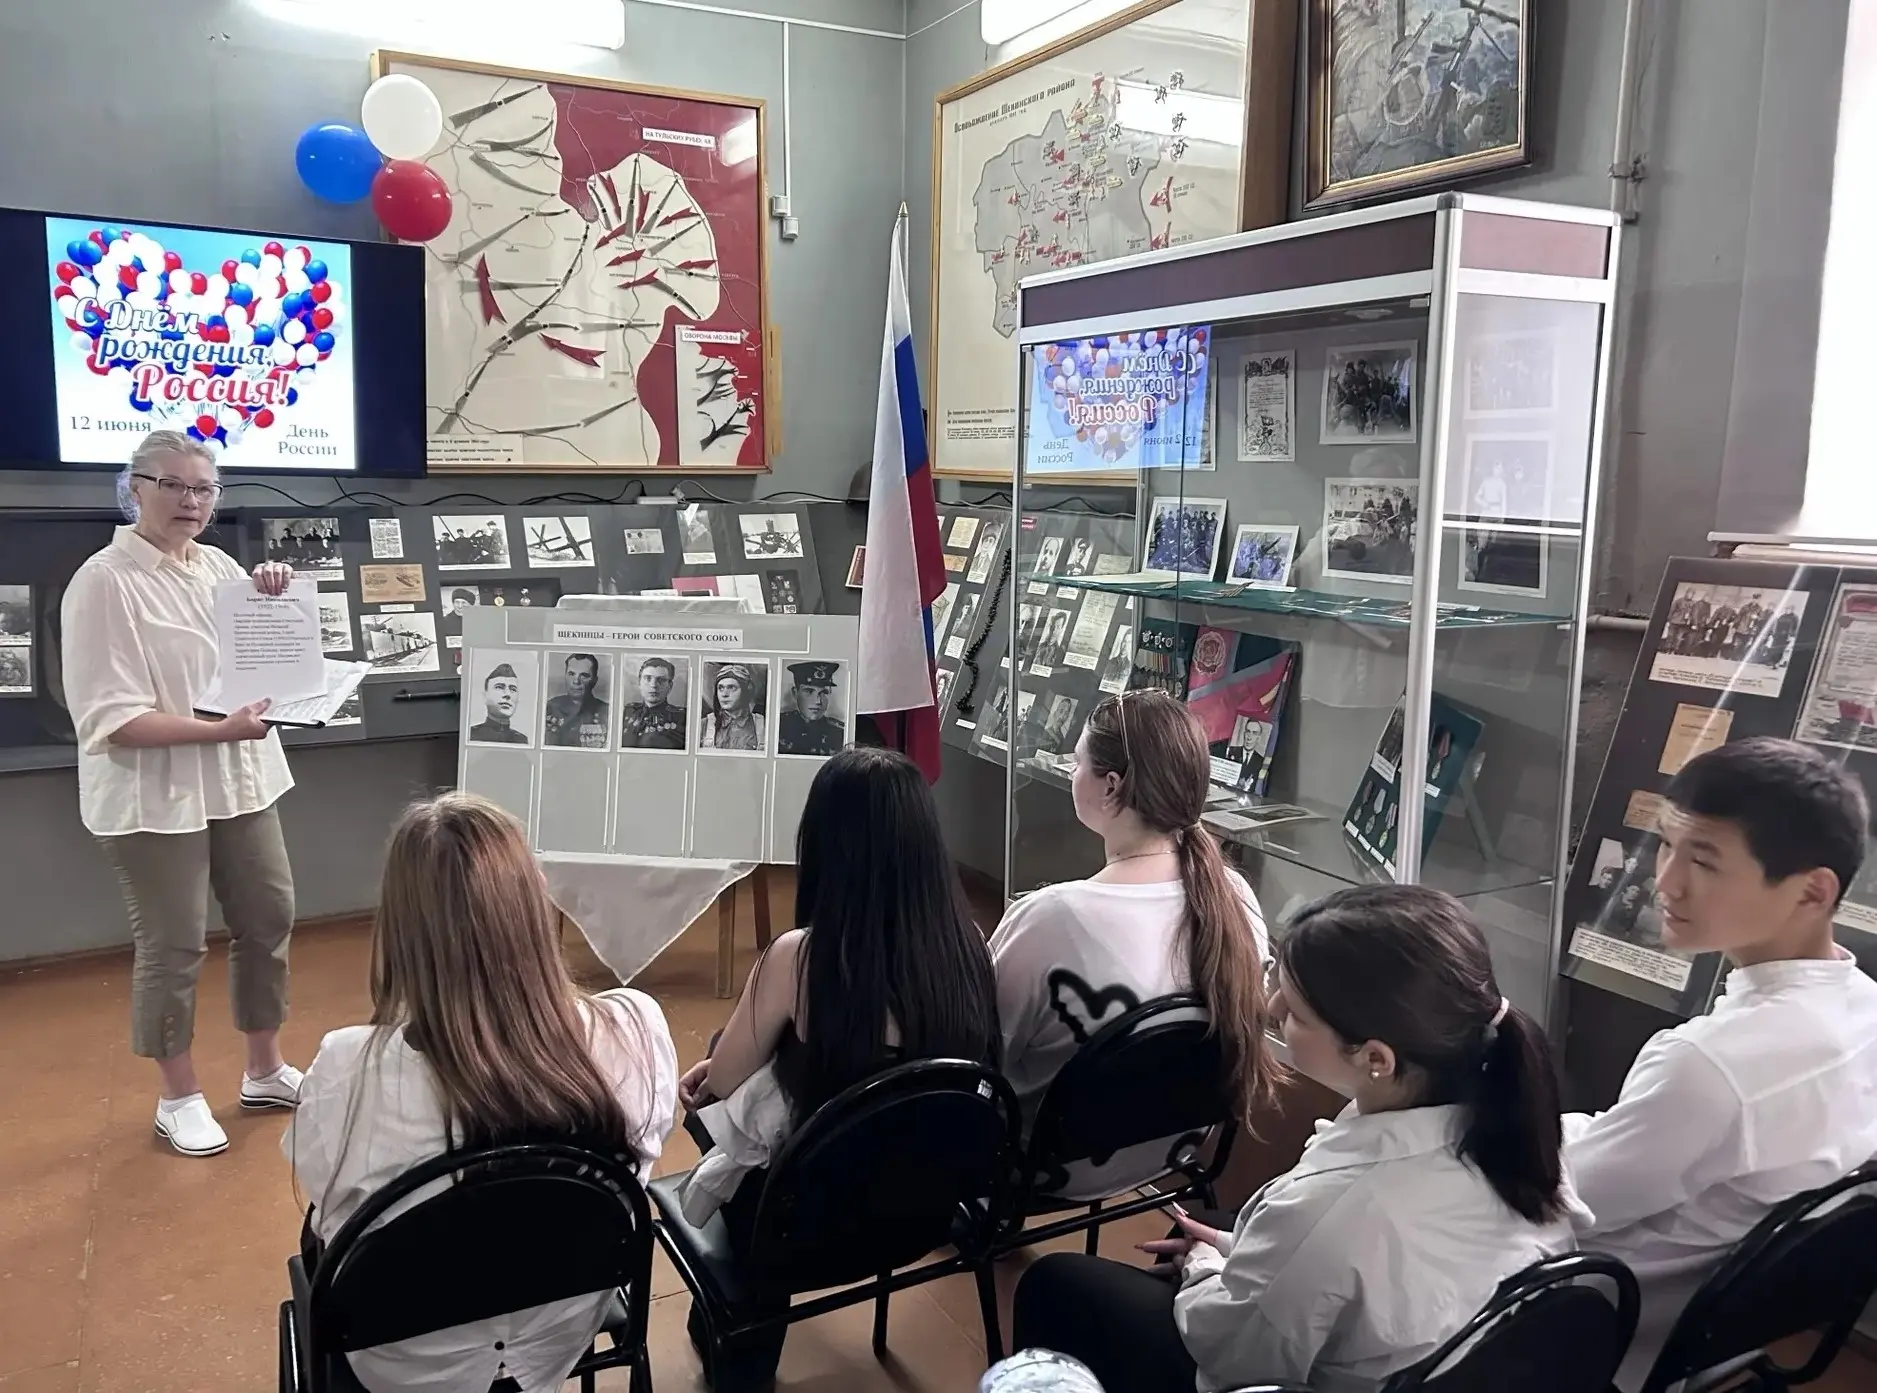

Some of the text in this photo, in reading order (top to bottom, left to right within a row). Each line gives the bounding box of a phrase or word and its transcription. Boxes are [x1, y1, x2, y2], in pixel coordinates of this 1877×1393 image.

[655, 132, 684, 140] ТУЛЬСКИХ
[685, 136, 712, 144] РУБЕАХ
[74, 296, 200, 335] С Днём
[684, 332, 712, 340] ОБОРОНА
[133, 363, 290, 405] Россия!
[71, 416, 151, 431] 12 июня
[286, 424, 329, 439] День
[277, 441, 337, 456] России
[557, 630, 605, 640] ЩЕКИНЦЫ
[612, 632, 640, 641] ГЕРОИ
[643, 632, 703, 642] СОВЕТСКОГО
[706, 634, 739, 643] СОЮЗА
